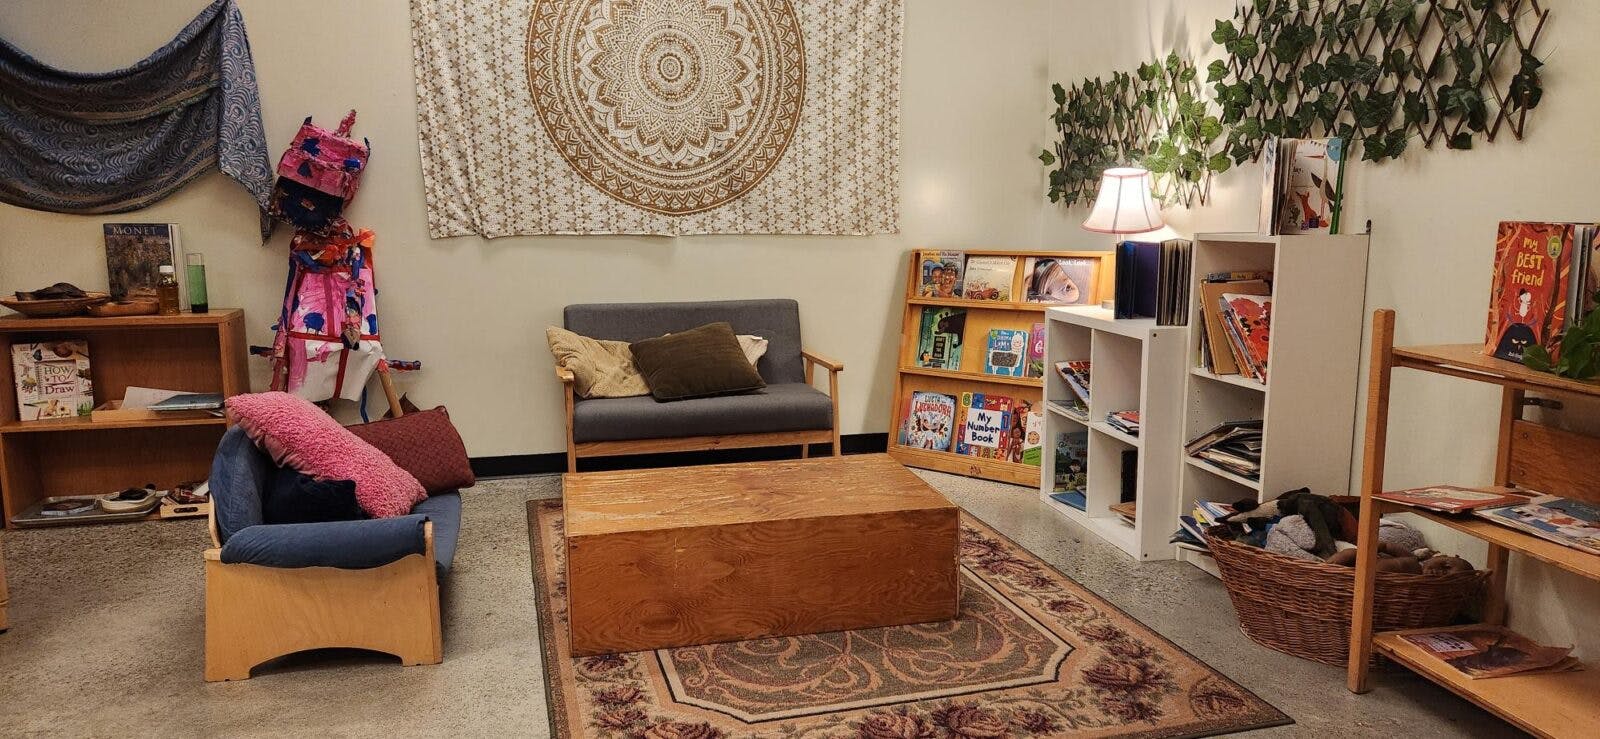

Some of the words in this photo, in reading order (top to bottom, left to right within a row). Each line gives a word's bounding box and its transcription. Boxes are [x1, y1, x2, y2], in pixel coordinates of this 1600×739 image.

[113, 226, 157, 235] MONET
[1516, 253, 1545, 270] BEST
[1512, 269, 1545, 286] friend
[44, 366, 71, 375] HOW
[50, 375, 67, 383] TO
[44, 385, 75, 394] Draw
[977, 412, 992, 424] My
[967, 421, 1000, 434] Number
[971, 431, 994, 443] Book
